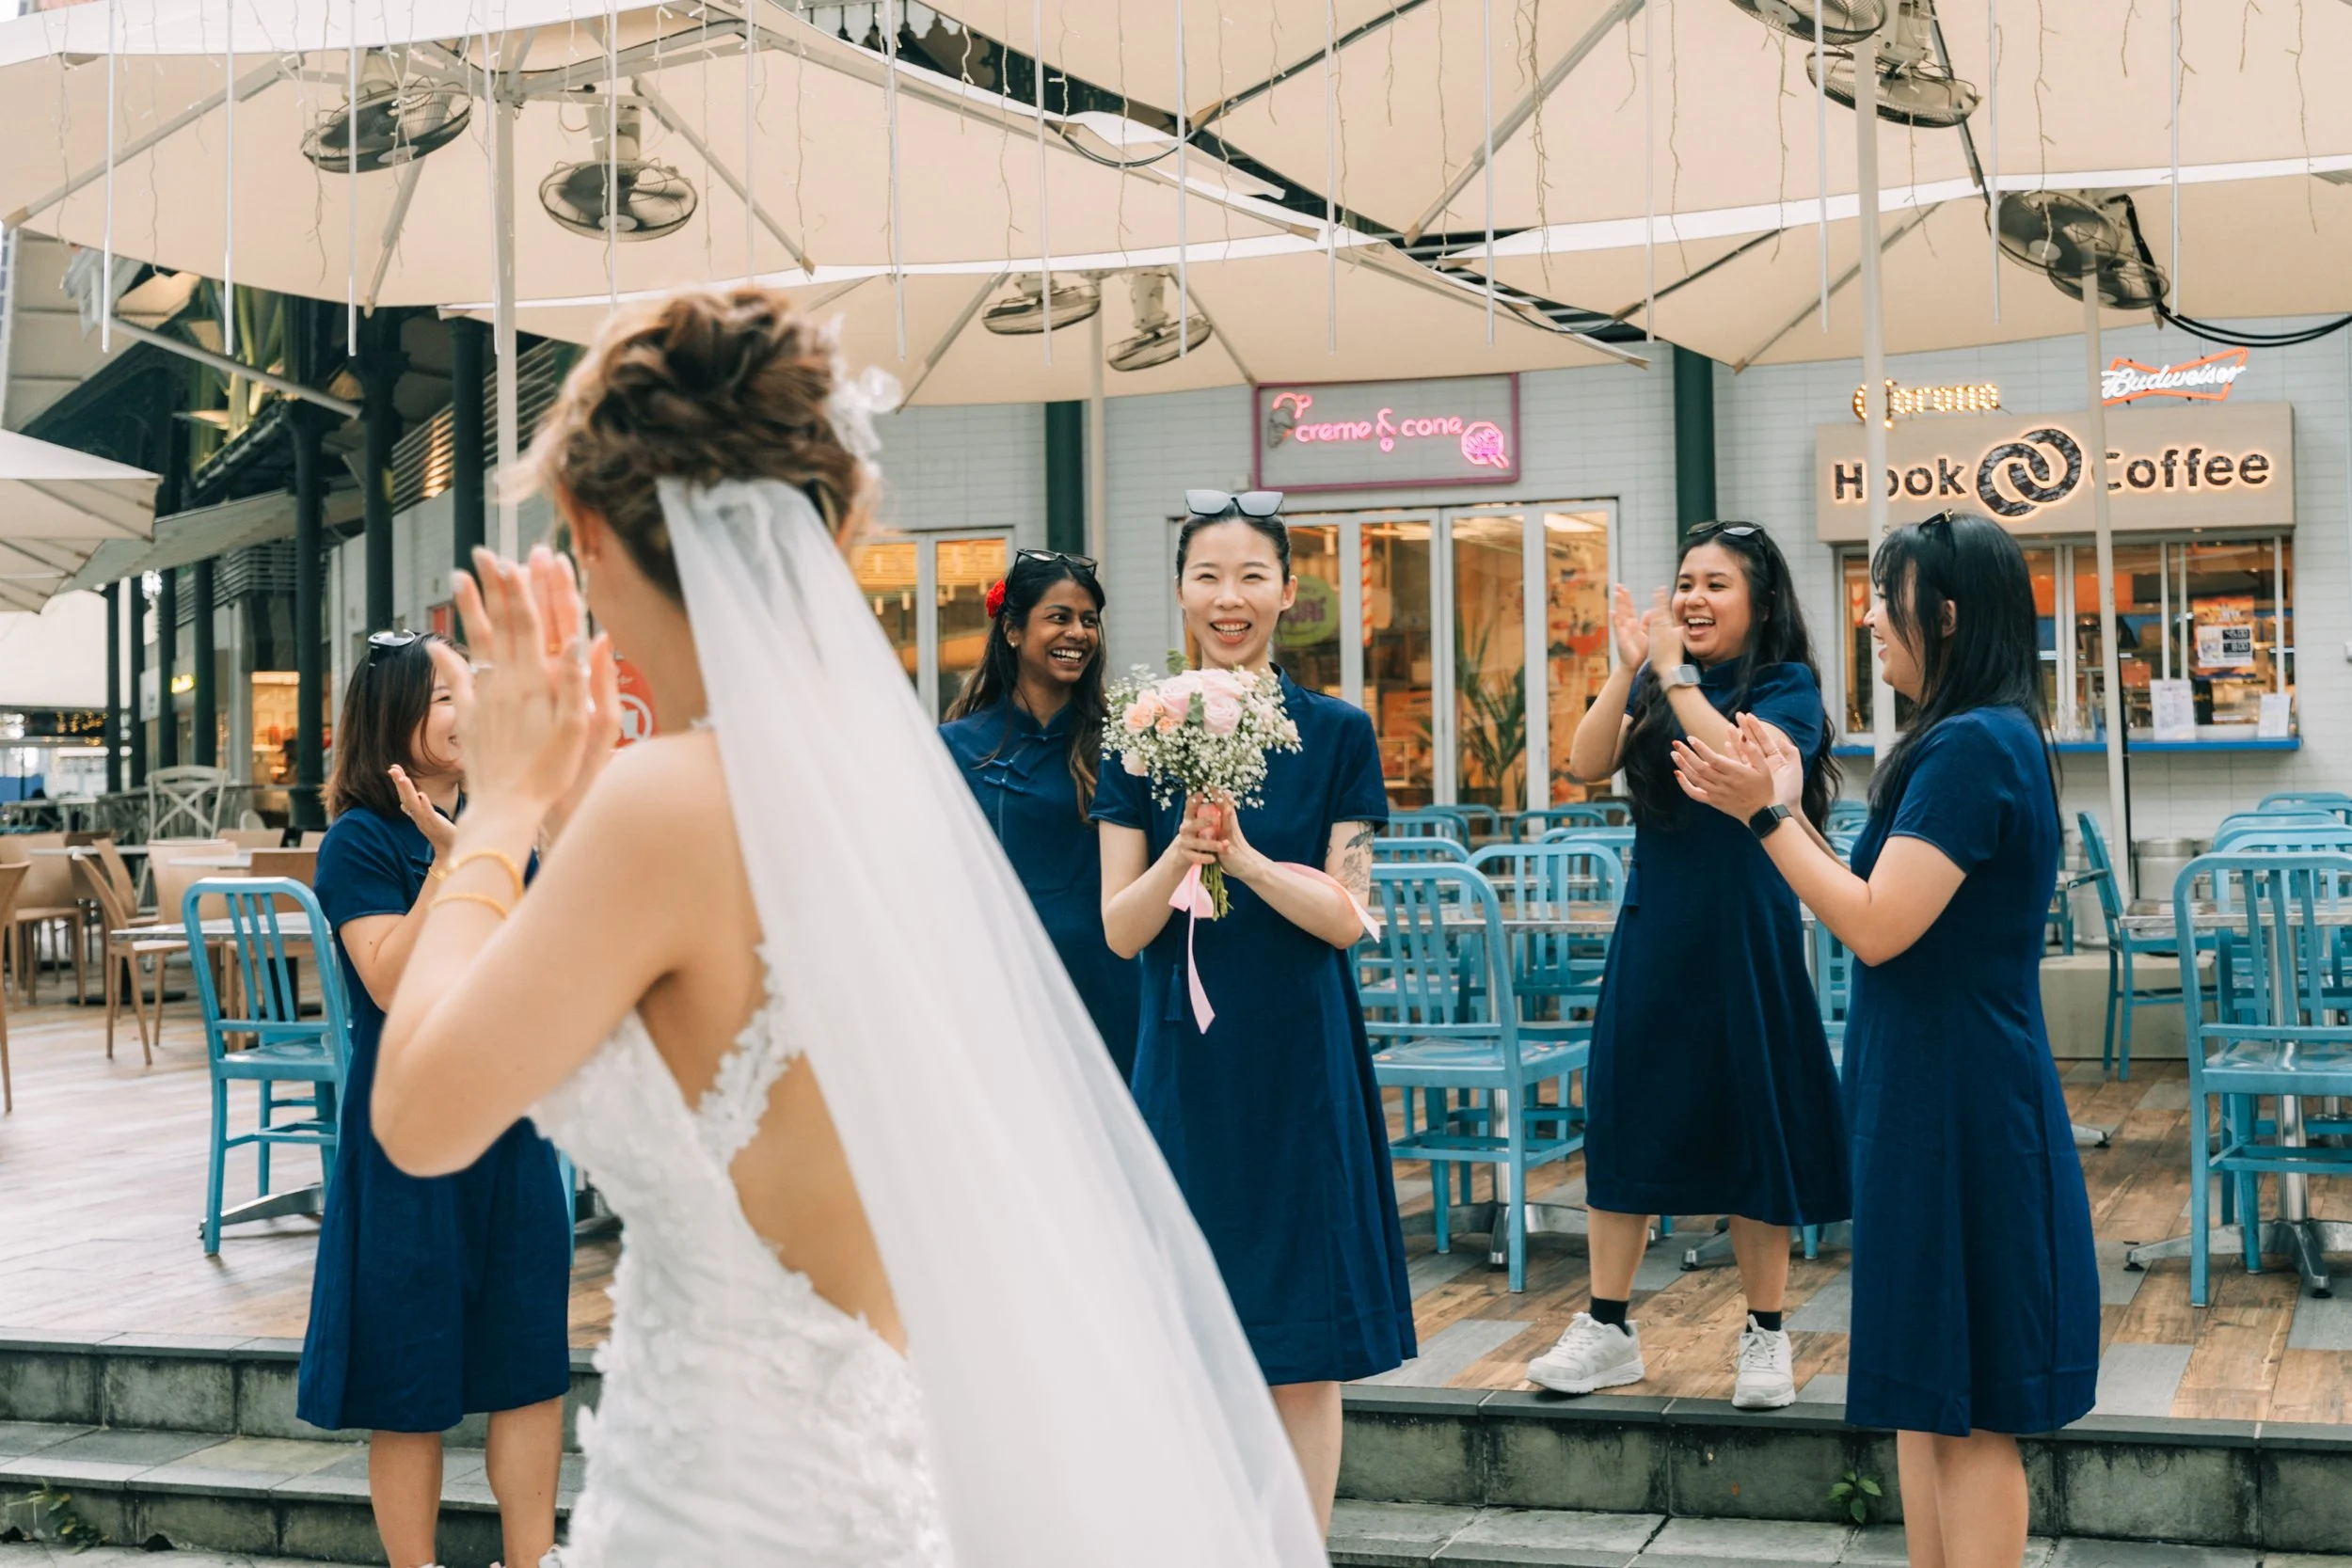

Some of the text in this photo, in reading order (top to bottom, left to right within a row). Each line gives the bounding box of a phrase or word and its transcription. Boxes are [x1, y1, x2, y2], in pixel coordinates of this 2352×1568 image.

[2101, 364, 2247, 399] Budweiser
[1295, 420, 1373, 443] creme
[1401, 416, 1464, 436] cone
